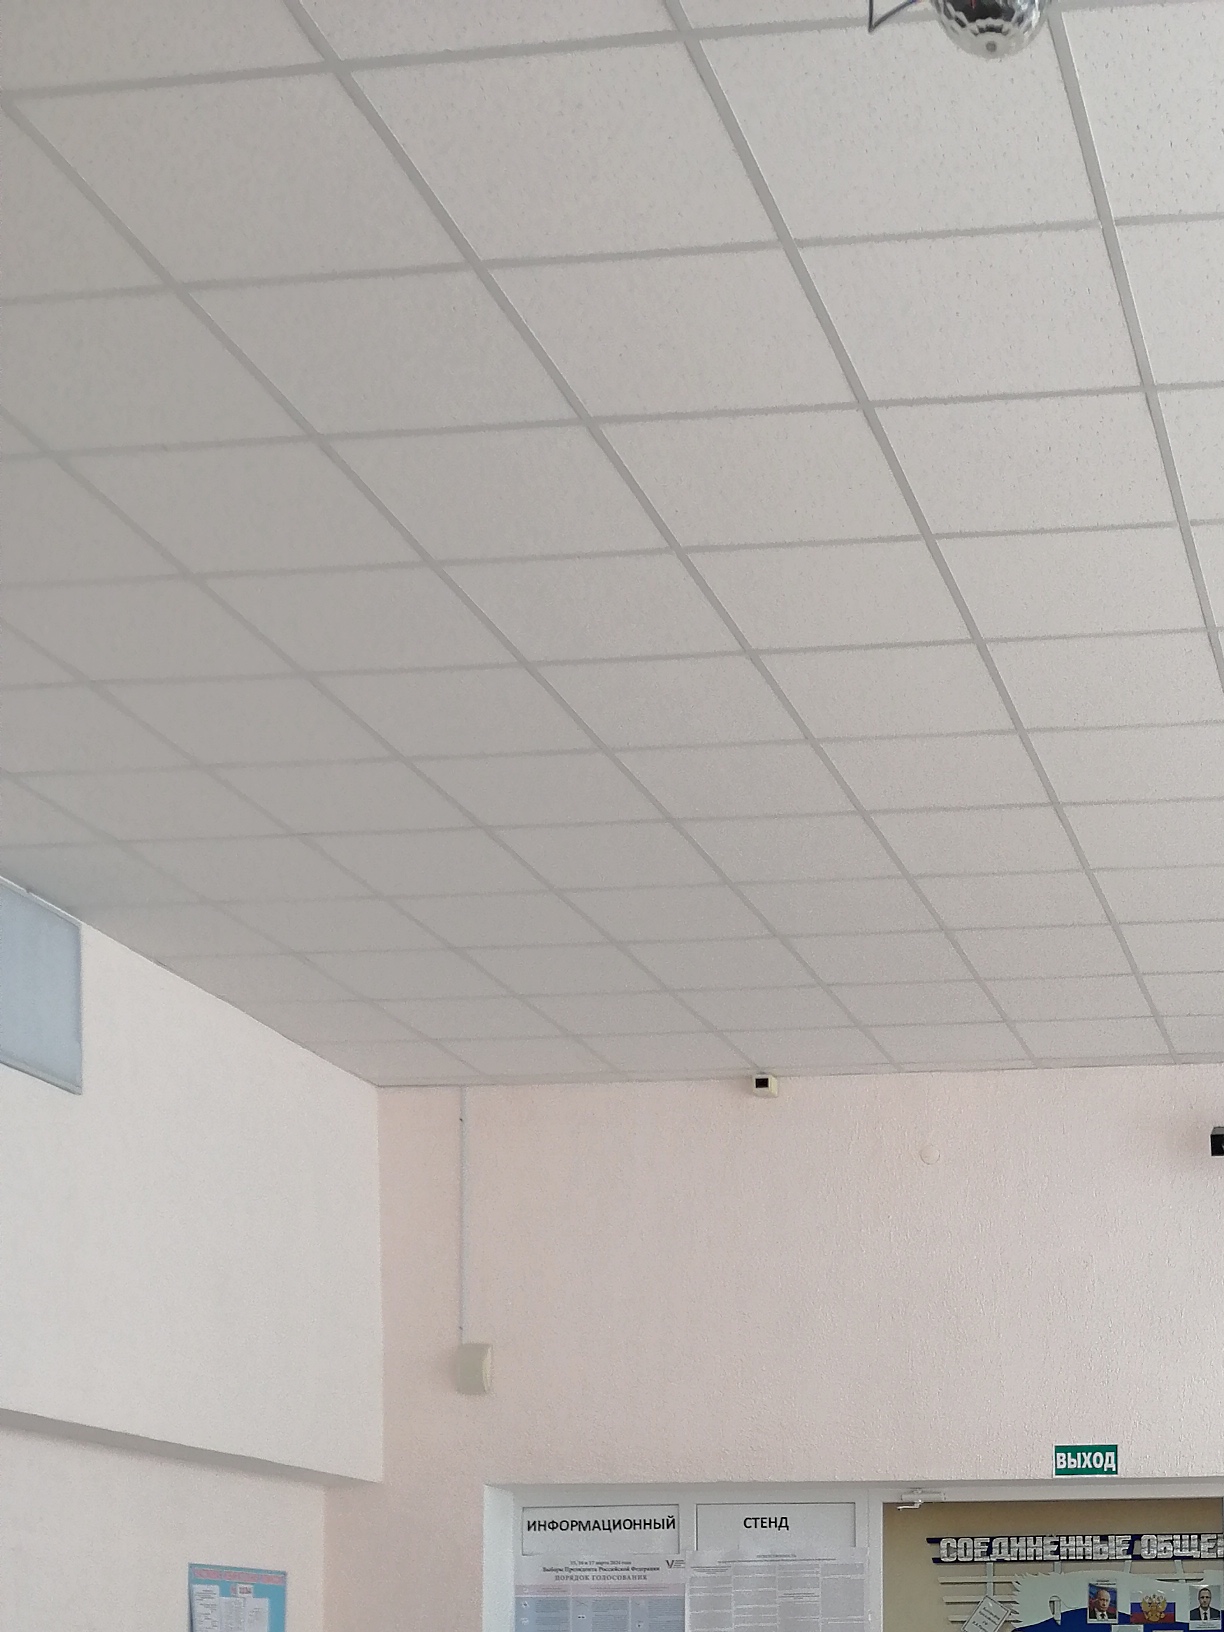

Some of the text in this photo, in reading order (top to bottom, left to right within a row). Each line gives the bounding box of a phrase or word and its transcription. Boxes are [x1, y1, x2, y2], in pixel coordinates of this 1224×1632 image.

[1056, 1452, 1116, 1471] ВЫХОД
[526, 1515, 790, 1533] ИНФОРМАЦИОННЫЙ СТЕНД
